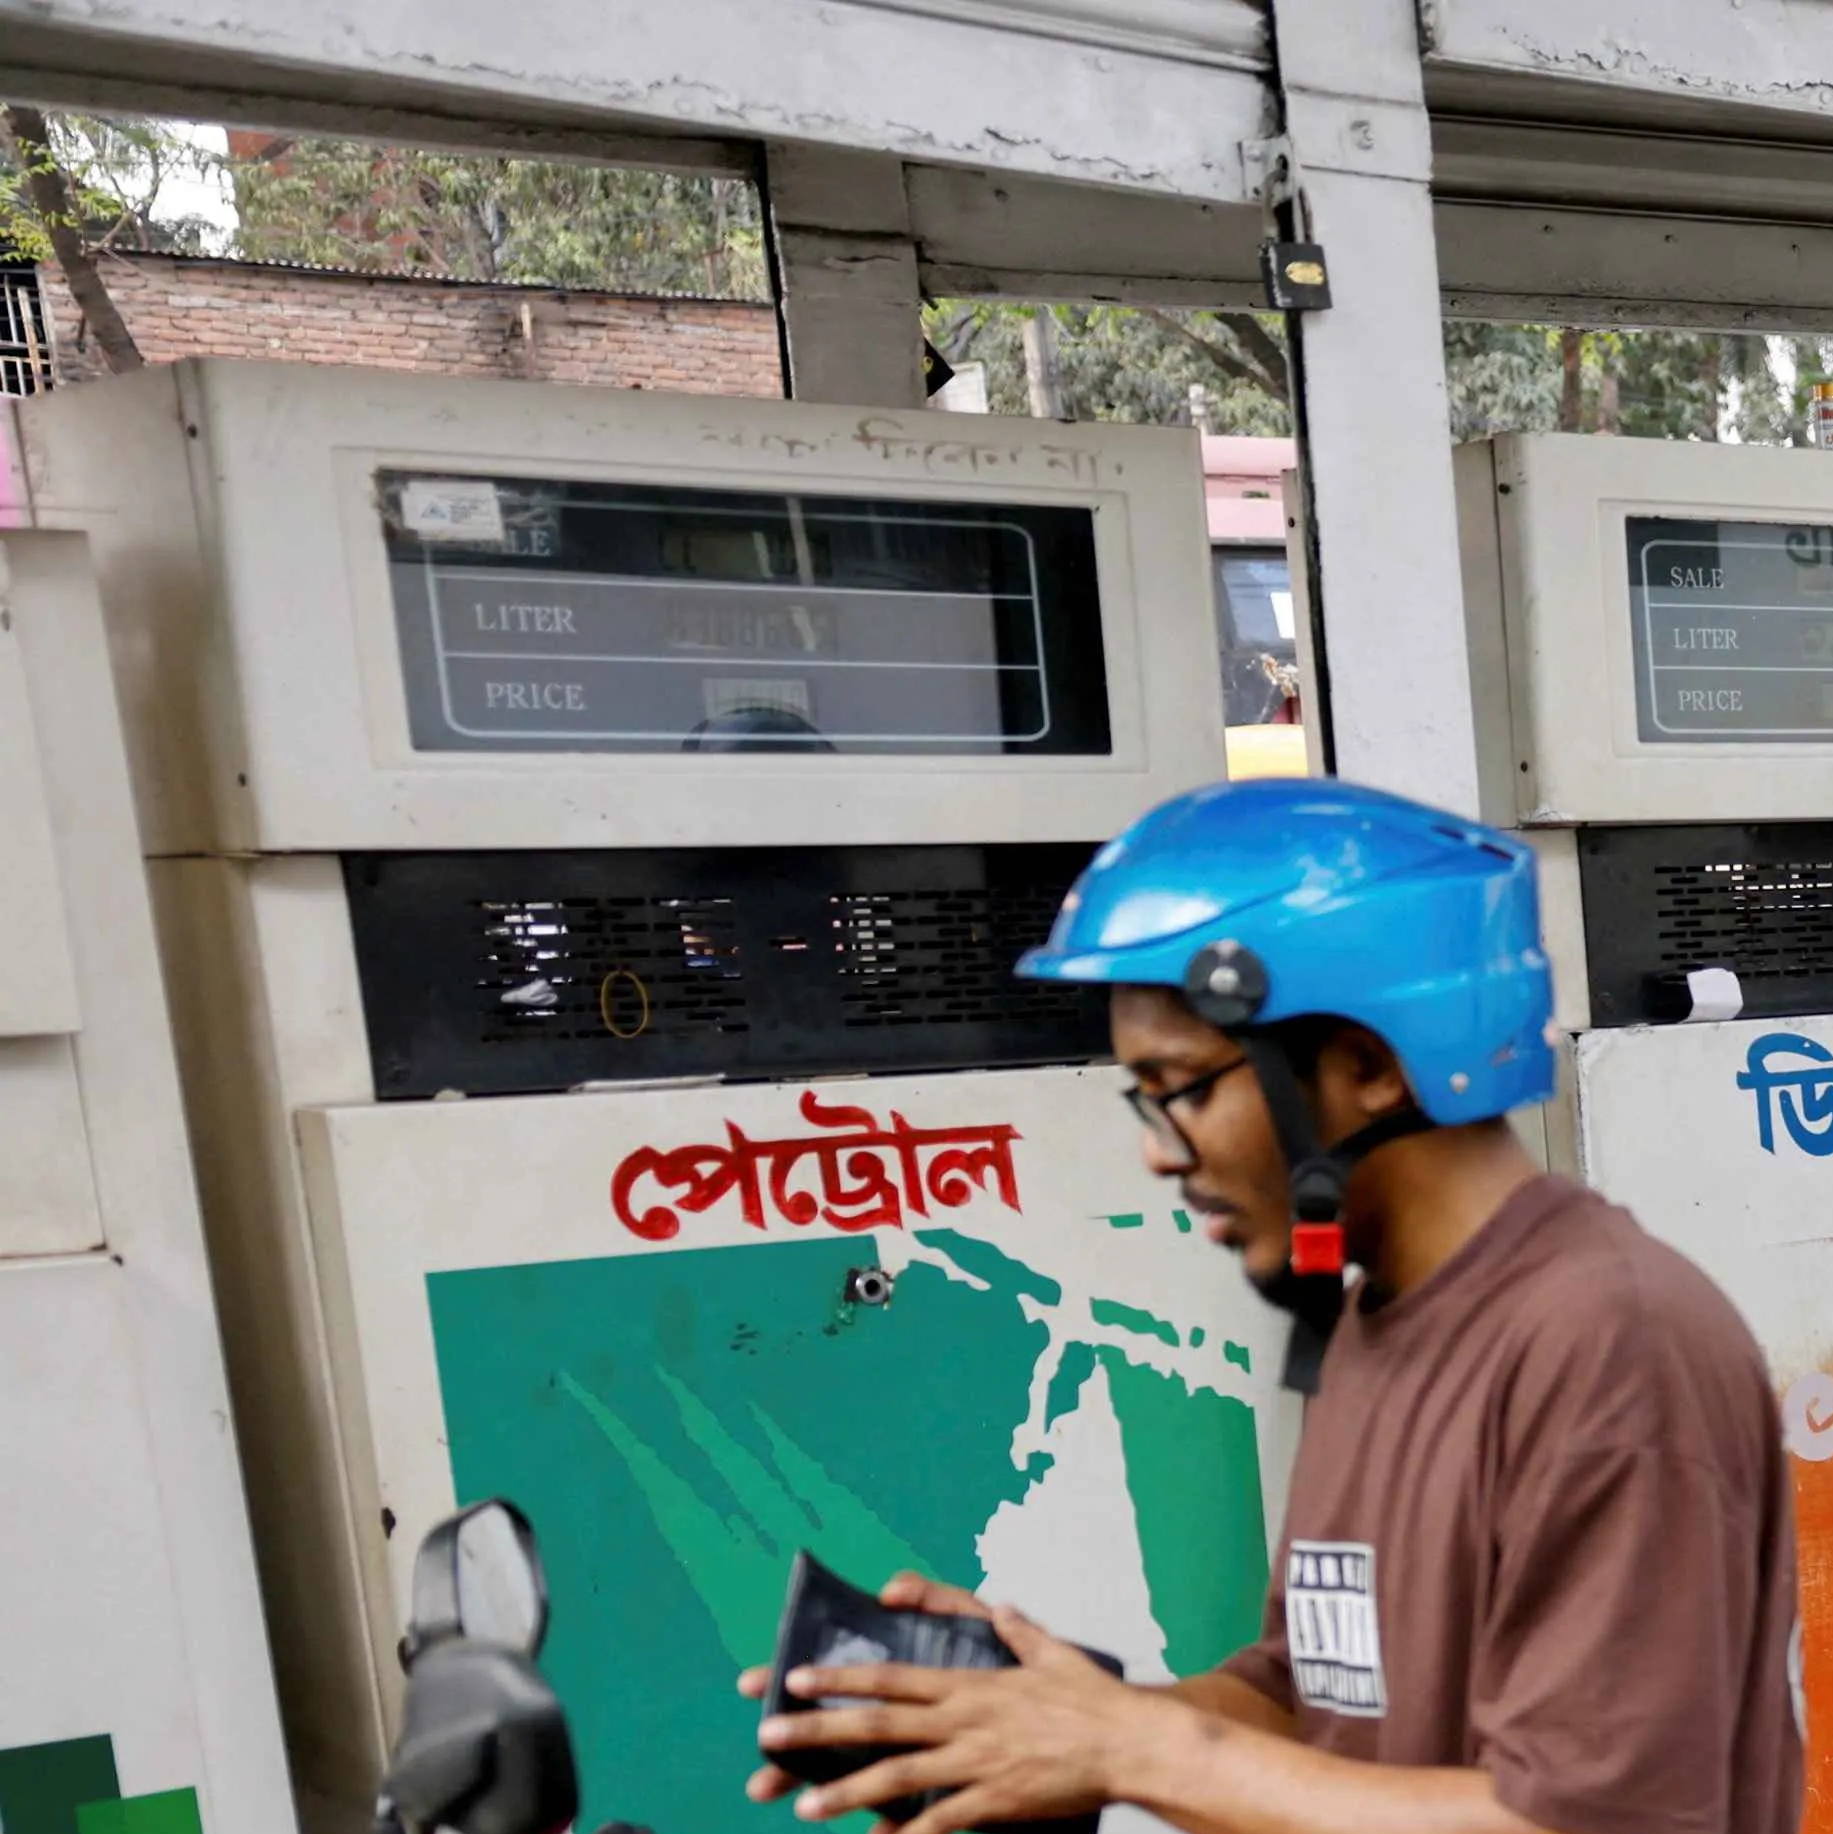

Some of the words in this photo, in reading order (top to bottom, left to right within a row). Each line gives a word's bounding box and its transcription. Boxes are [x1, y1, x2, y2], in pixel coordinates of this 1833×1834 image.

[1670, 567, 1724, 590] SALE
[475, 603, 577, 634] LITER
[1673, 628, 1739, 650] LITER
[485, 682, 588, 711] PRICE
[1678, 690, 1743, 712] PRICE
[611, 1089, 1024, 1241] পেট্রোল
